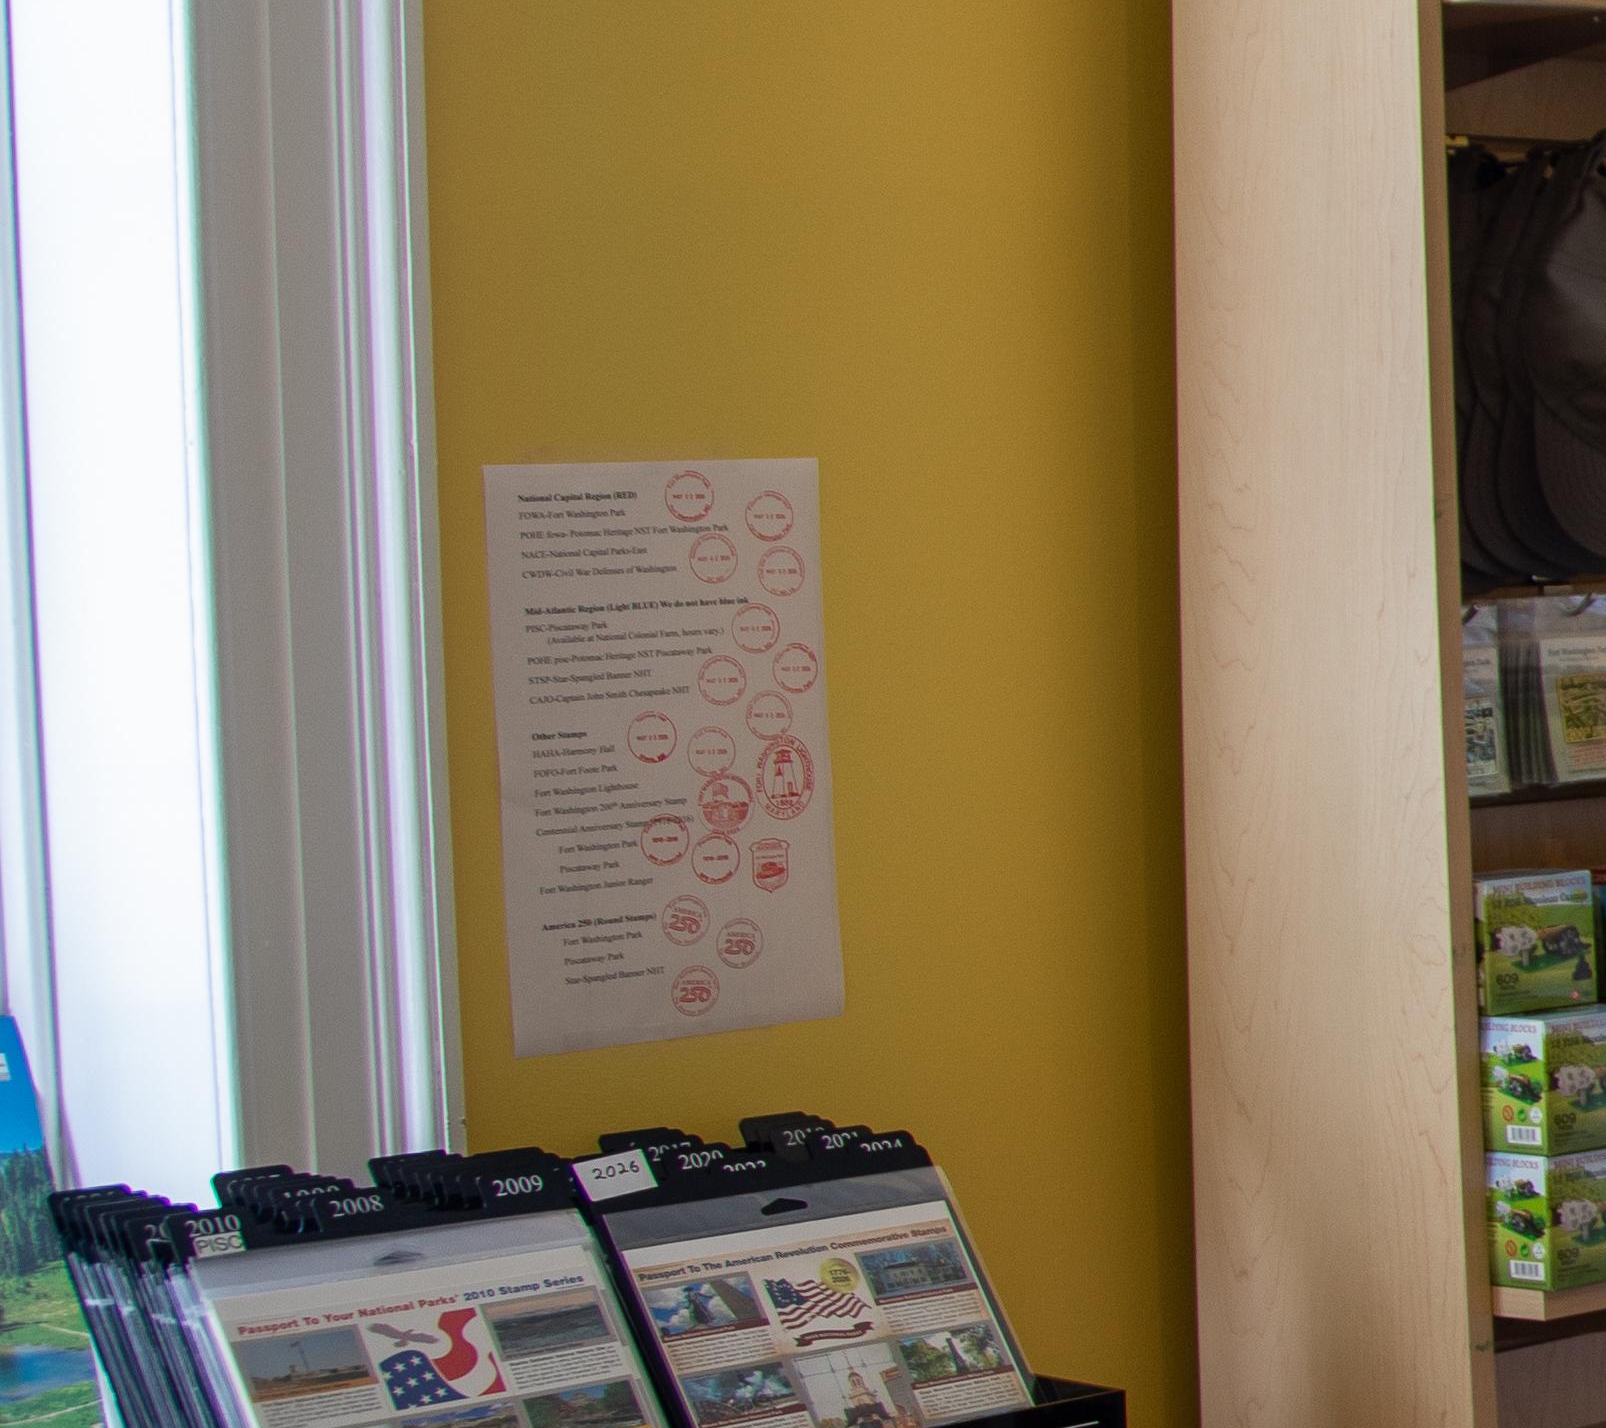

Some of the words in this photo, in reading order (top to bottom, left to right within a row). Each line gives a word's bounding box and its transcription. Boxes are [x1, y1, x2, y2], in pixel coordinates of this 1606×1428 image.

[553, 492, 584, 503] Capital
[584, 492, 612, 502] Region
[566, 509, 609, 520] Washington
[609, 508, 627, 517] Park
[577, 603, 605, 615] Region
[659, 599, 673, 609] We
[674, 599, 685, 608] do
[685, 598, 699, 607] not
[699, 597, 718, 606] have
[718, 596, 736, 605] blue
[736, 595, 750, 605] ink
[531, 732, 556, 741] Other
[557, 730, 588, 740] Stamps
[592, 1161, 641, 1181] 2026
[491, 1175, 544, 1199] 2009
[330, 1194, 385, 1219] 2008
[185, 1214, 242, 1239] 2010
[194, 1233, 243, 1258] PISC
[637, 1265, 686, 1283] Passport
[686, 1262, 702, 1274] To
[702, 1258, 724, 1272] The
[725, 1252, 774, 1270] American
[774, 1243, 829, 1262] Revolution
[829, 1230, 910, 1253] Commemorative
[911, 1223, 948, 1238] Stamps
[237, 1318, 299, 1337] Passport
[302, 1314, 320, 1327] To
[322, 1308, 356, 1324] Your
[357, 1298, 416, 1319] National
[462, 1287, 497, 1302] 2010
[498, 1281, 542, 1300] Stamp
[542, 1273, 586, 1291] Series
